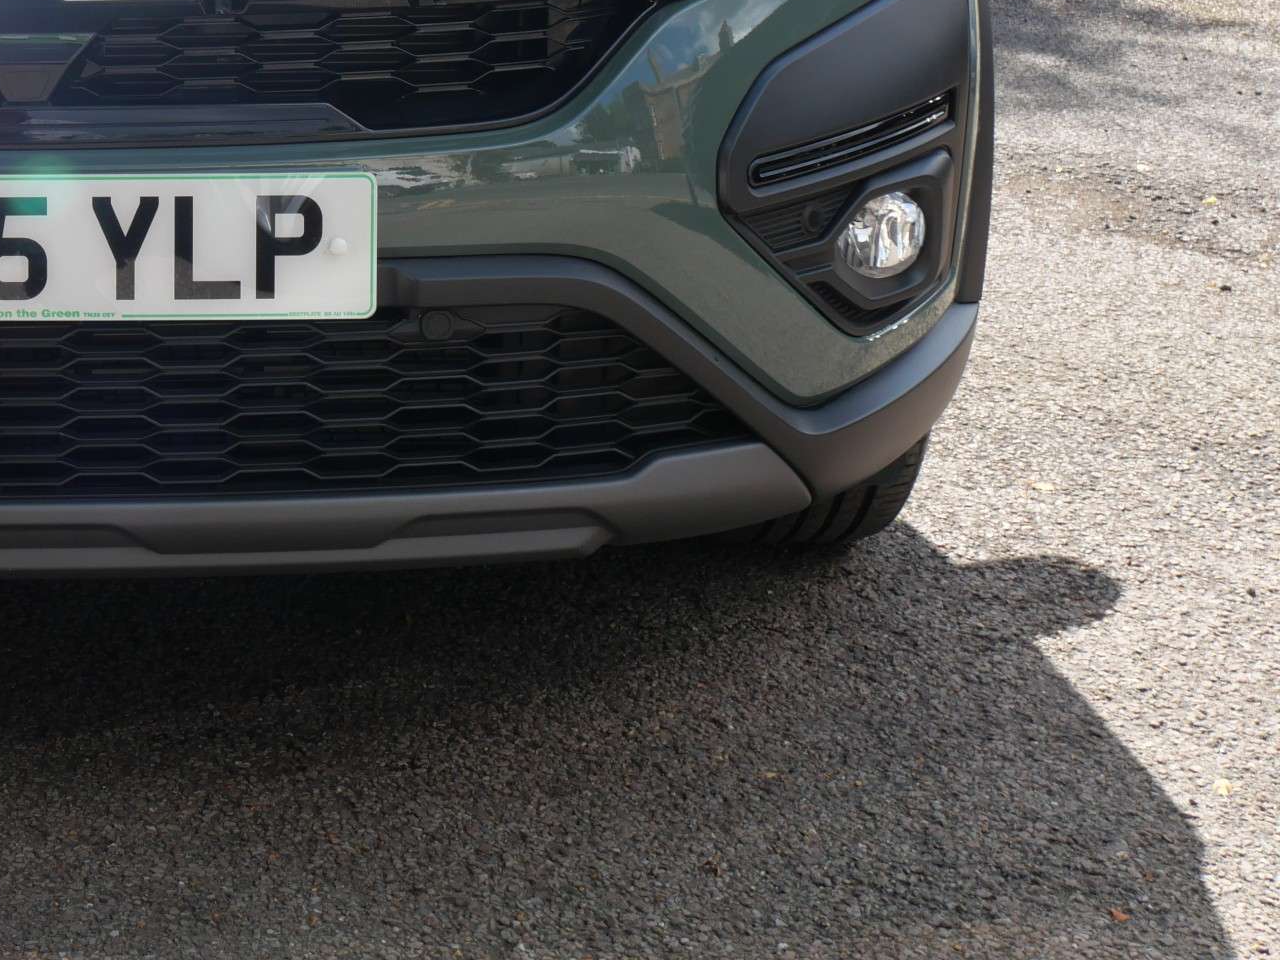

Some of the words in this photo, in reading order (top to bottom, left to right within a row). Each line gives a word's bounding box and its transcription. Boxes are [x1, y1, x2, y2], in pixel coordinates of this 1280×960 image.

[91, 195, 323, 300] YLP
[16, 308, 37, 319] the
[41, 308, 81, 319] Green
